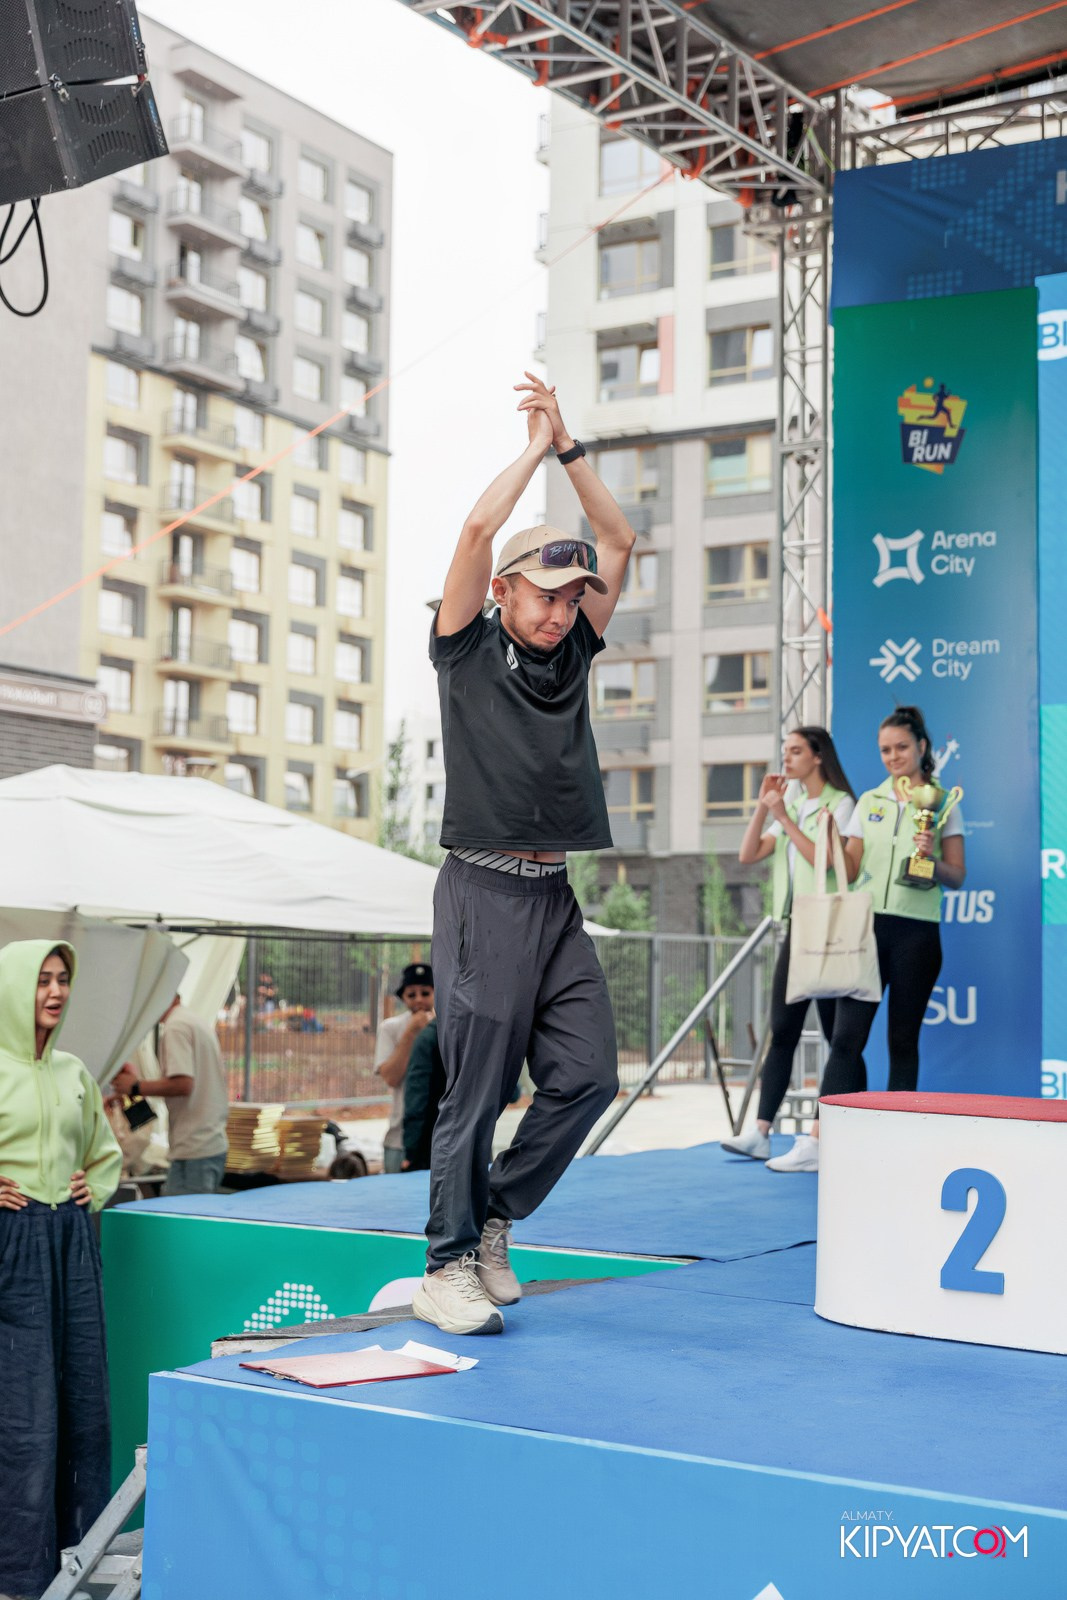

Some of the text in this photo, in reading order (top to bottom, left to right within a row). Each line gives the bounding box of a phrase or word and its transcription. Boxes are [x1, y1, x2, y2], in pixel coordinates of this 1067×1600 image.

[908, 429, 929, 448] BI
[912, 442, 952, 463] RUN
[931, 530, 996, 551] Arena
[931, 554, 975, 577] City
[932, 638, 1000, 657] Dream
[932, 659, 972, 681] City
[940, 1167, 1007, 1295] 2
